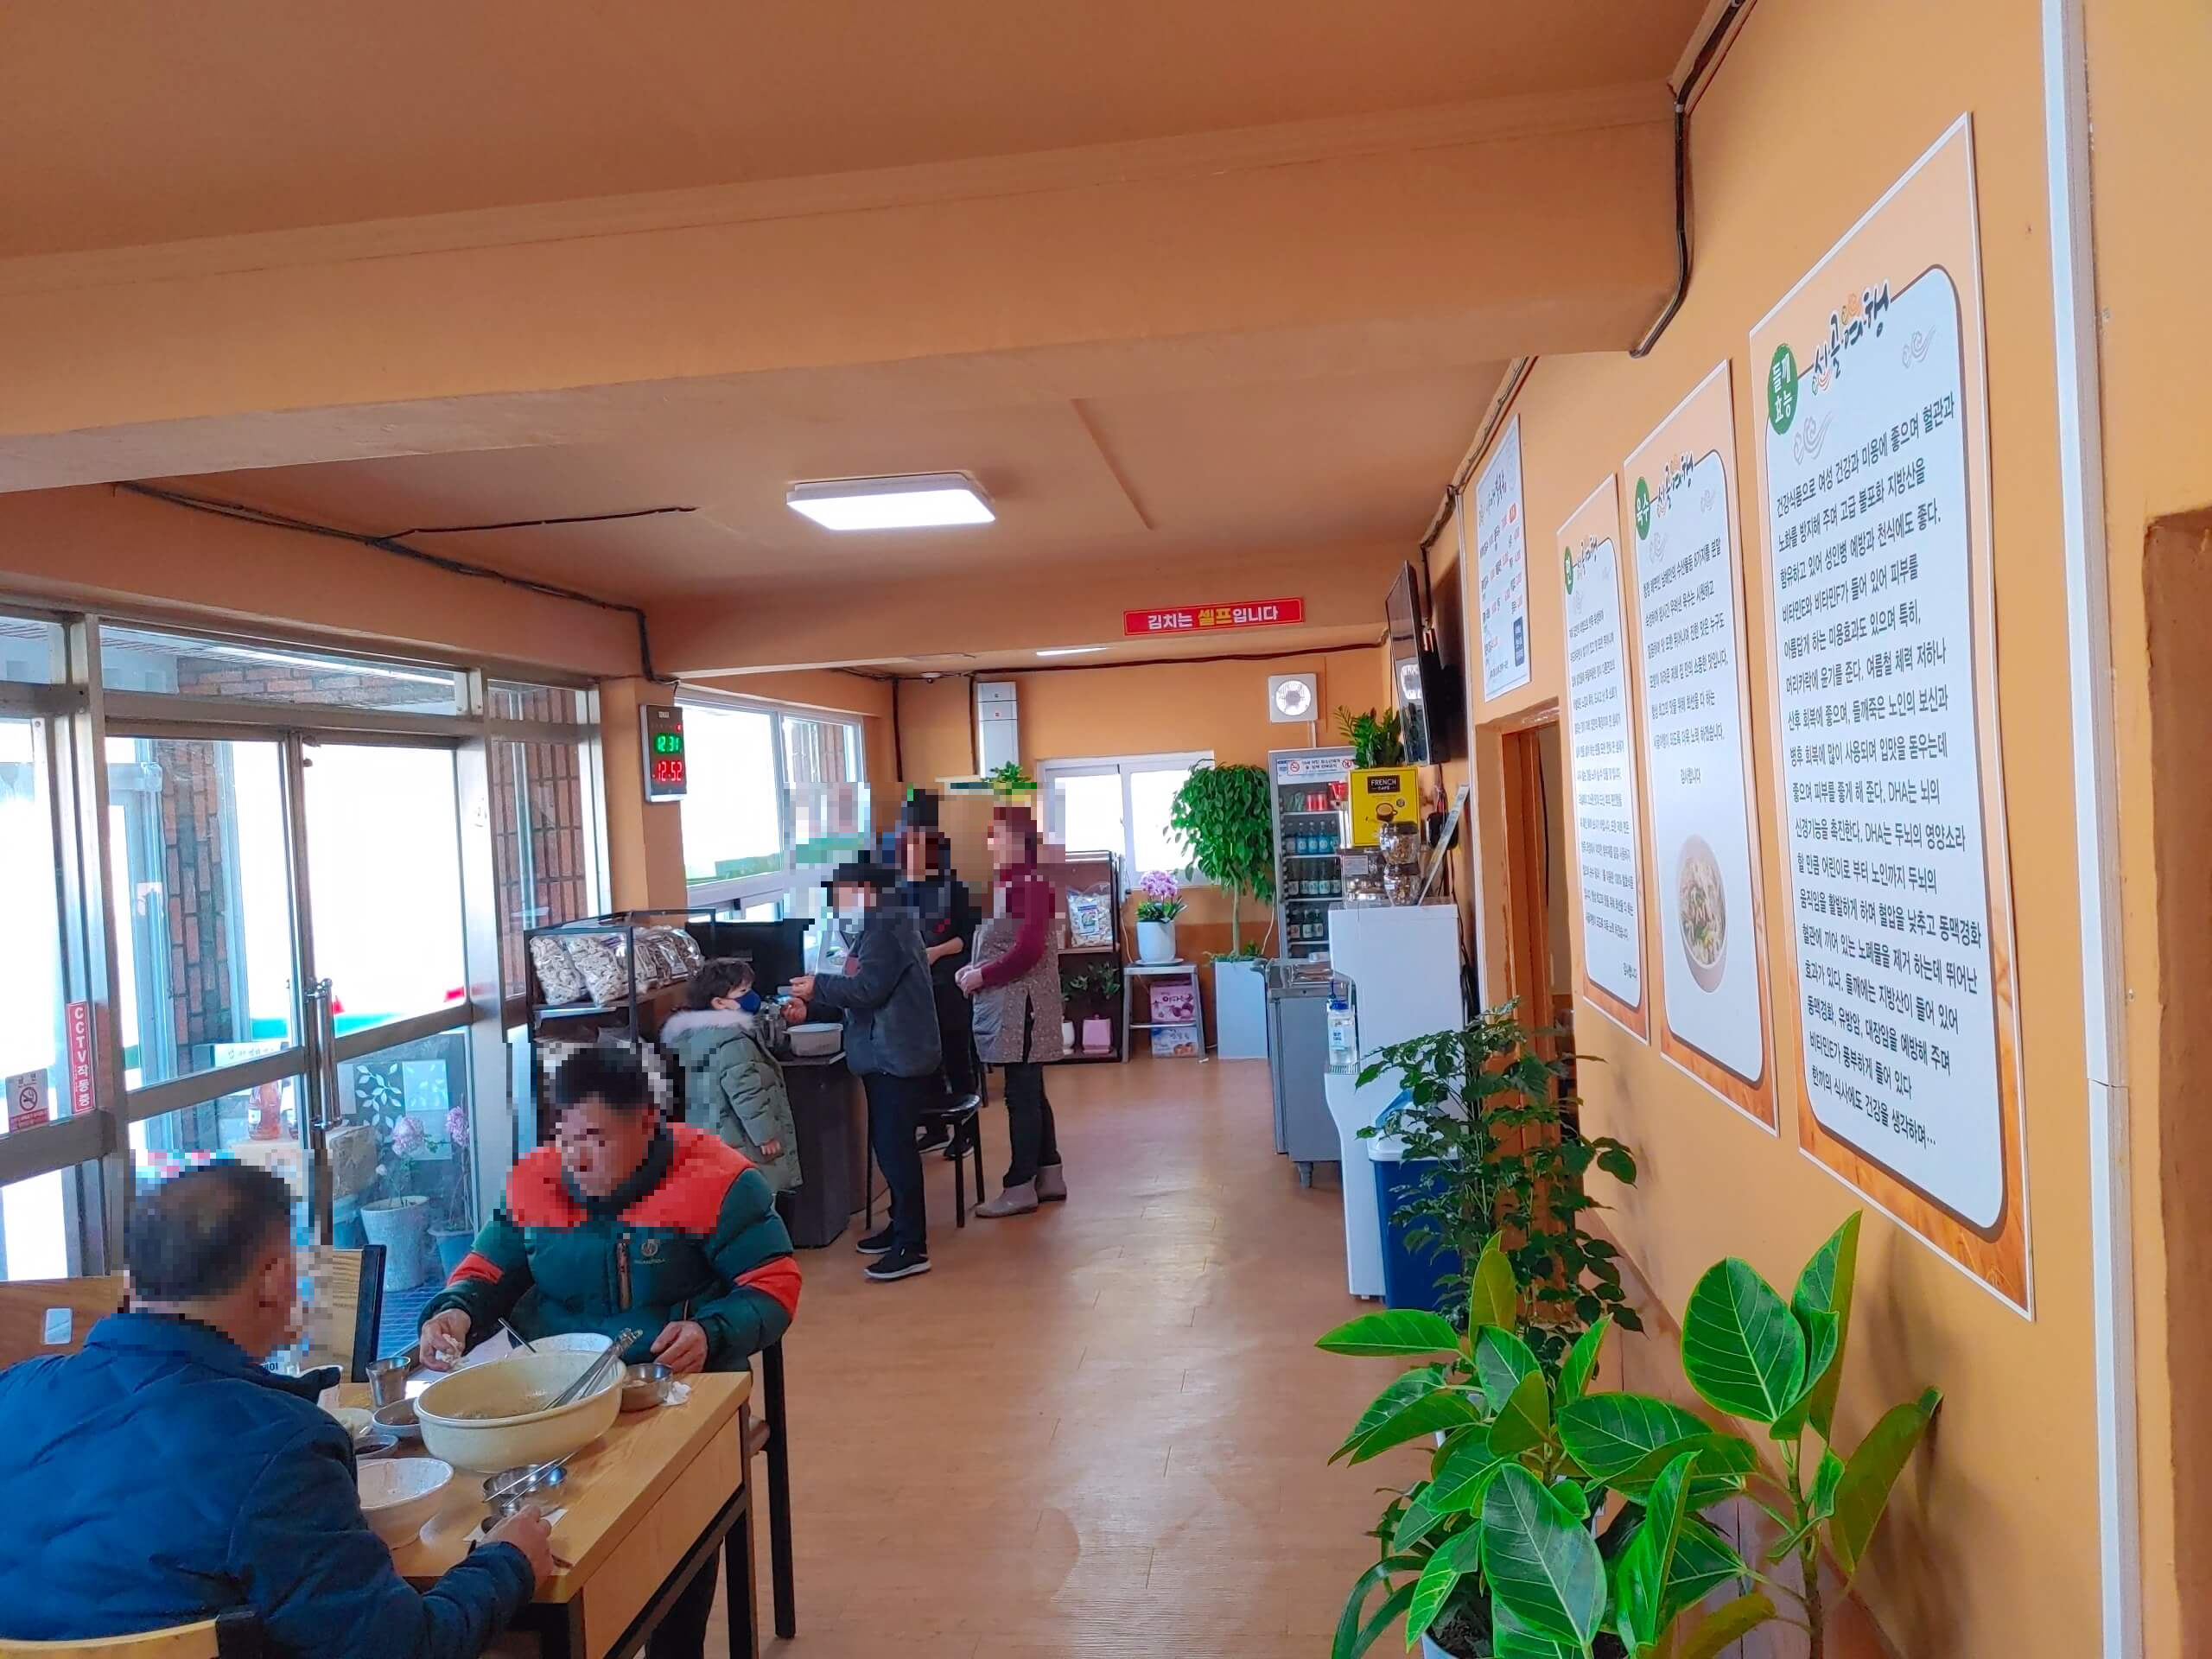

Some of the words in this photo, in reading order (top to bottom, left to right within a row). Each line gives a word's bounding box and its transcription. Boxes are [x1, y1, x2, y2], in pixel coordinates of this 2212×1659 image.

[1772, 353, 1791, 393] 들깨
[1775, 390, 1793, 423] 효능
[1777, 477, 1816, 518] 건강식품으로
[1818, 465, 1833, 493] 여성
[1835, 449, 1859, 484] 건강과
[1861, 430, 1887, 467] 미용에
[1890, 412, 1919, 453] 좋으며
[1922, 391, 1955, 433] 혈관과
[1637, 493, 1649, 525] 육수
[1778, 524, 1797, 552] 노화를
[1799, 512, 1821, 543] 방지해
[1822, 503, 1837, 531] 주며
[1840, 494, 1856, 521] 고급
[1858, 478, 1885, 513] 불포화
[1887, 456, 1925, 497] 지방산을
[1779, 561, 1807, 589] 함유하고
[1808, 550, 1822, 577] 있어
[1824, 538, 1847, 570] 성인병
[1849, 526, 1874, 557] 예방과
[1877, 511, 1914, 547] 천식에도
[1850, 572, 1866, 601] 들어
[1870, 564, 1887, 594] 있어
[1890, 553, 1918, 585] 피부를
[1147, 613, 1193, 630] 김치는
[1198, 606, 1279, 627] 셀프입니다
[1783, 632, 1809, 660] 아름답게
[1811, 628, 1827, 652] 하는
[1828, 616, 1867, 647] 미용효과도
[1869, 605, 1896, 636] 있으며
[1785, 668, 1818, 696] 머리카락에
[1820, 663, 1843, 689] 윤기를
[1866, 650, 1892, 679] 여름철
[1895, 645, 1913, 672] 체력
[1916, 637, 1946, 668] 저하나
[1788, 709, 1801, 731] 산후
[1802, 705, 1823, 729] 회복에
[1852, 695, 1885, 722] 들깨죽은
[1888, 690, 1915, 716] 노인의
[1918, 683, 1948, 712] 보신과
[1804, 743, 1826, 766] 회복에
[1827, 741, 1842, 765] 많이
[1845, 738, 1877, 764] 사용되며
[1879, 735, 1905, 761] 입맛을
[1792, 781, 1812, 803] 좋으며
[1814, 780, 1835, 803] 피부를
[1837, 780, 1853, 803] 좋게
[1854, 780, 1864, 803] 해
[1887, 779, 1916, 804] DHA는
[1920, 778, 1940, 804] 뇌의
[1795, 817, 1828, 840] 신경기능을
[1865, 821, 1891, 845] DHA는
[1894, 822, 1922, 849] 두뇌의
[1924, 823, 1965, 852] 영양소라
[1805, 854, 1821, 875] 만큼
[1821, 855, 1851, 880] 어린이로
[1853, 859, 1868, 884] 부터
[1871, 861, 1905, 890] 노인까지
[1908, 866, 1936, 894] 두뇌의
[1799, 887, 1827, 913] 움직임을
[1827, 893, 1858, 920] 활발하게
[1859, 899, 1876, 925] 하며
[1878, 902, 1904, 931] 혈압을
[1907, 908, 1936, 936] 낮추고
[1939, 914, 1981, 949] 동맥경화
[1802, 922, 1822, 949] 혈관에
[1824, 929, 1838, 954] 끼어
[1840, 933, 1855, 958] 있는
[1858, 938, 1890, 969] 노폐물을
[1892, 948, 1910, 975] 제거
[1913, 953, 1942, 984] 하는데
[1945, 961, 1977, 995] 뛰어난
[1804, 959, 1825, 986] 효과가
[1845, 972, 1876, 1003] 들깨에는
[1878, 984, 1913, 1018] 지방산이
[1915, 995, 1935, 1026] 들어
[1937, 1003, 1958, 1034] 있어
[1840, 1045, 1872, 1081] 풍부하게
[1874, 1059, 1891, 1090] 들어
[1894, 1070, 1911, 1099] 있다
[1865, 1018, 1897, 1052] 대장암을
[1900, 1033, 1928, 1065] 예방해
[1930, 1044, 1950, 1076] 주며
[1834, 1077, 1863, 1110] 식사에도
[1865, 1094, 1889, 1127] 건강을
